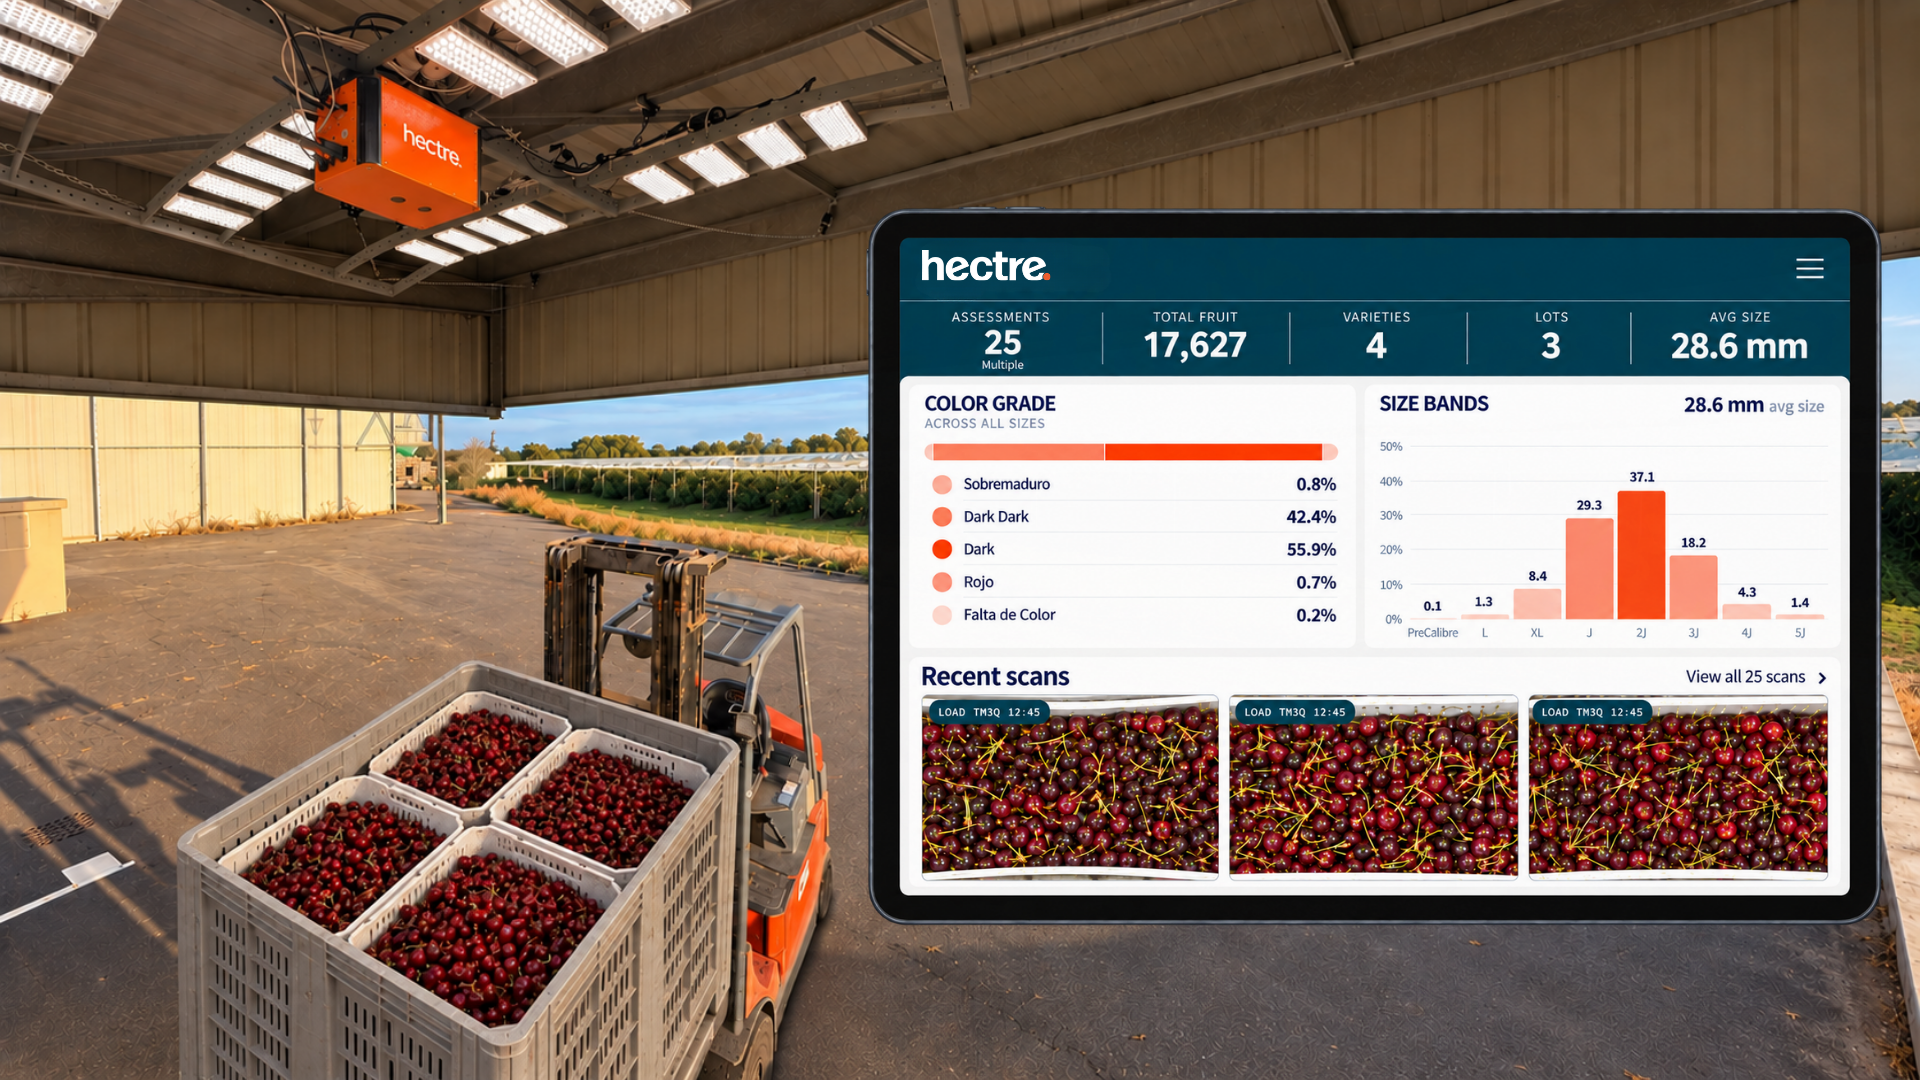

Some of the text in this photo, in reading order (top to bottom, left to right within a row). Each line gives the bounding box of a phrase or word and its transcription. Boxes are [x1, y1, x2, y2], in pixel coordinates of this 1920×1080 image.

[951, 312, 1050, 323] ASSESSMENTS
[1153, 312, 1238, 323] TOTAL FRUIT
[1342, 312, 1411, 323] VARIETIES
[1535, 312, 1569, 323] LOTS
[1709, 312, 1771, 323] AVG SIZE
[985, 330, 1021, 355] 25
[1145, 331, 1246, 363] 17,627
[1366, 332, 1387, 358] 4
[1542, 332, 1560, 359] 3
[1672, 333, 1807, 359] 28.6 mm
[982, 360, 1024, 371] Multiple
[925, 396, 1055, 411] COLOR GRADE
[1380, 396, 1489, 411] SIZE BANDS
[1685, 397, 1824, 415] 28.6 mm avg size
[924, 418, 1045, 429] ACROSS ALL SIZES
[1379, 442, 1404, 452] 50%
[1379, 477, 1404, 487] 40%
[1629, 472, 1655, 483] 37.1
[964, 477, 1050, 490] Sobremaduro
[1297, 477, 1336, 491] 0.8%
[1576, 500, 1603, 511] 29.3
[965, 510, 1029, 522] Dark Dark
[1287, 510, 1336, 523] 42.4%
[1379, 511, 1404, 521] 30%
[965, 542, 994, 555] Dark
[1681, 538, 1707, 548] 18.2
[1288, 543, 1336, 556] 55.9%
[1379, 545, 1404, 555] 20%
[1528, 571, 1548, 582] 8.4
[965, 576, 994, 591] Rojo
[1297, 576, 1336, 589] 0.7%
[1380, 580, 1404, 590] 10%
[1737, 587, 1757, 598] 4.3
[1423, 601, 1442, 612] 0.1
[1474, 597, 1493, 607] 1.3
[1791, 598, 1810, 608] 1.4
[965, 608, 1056, 620] Falta de Color
[1297, 609, 1336, 622] 0.2%
[1385, 615, 1403, 625] 0%
[1407, 628, 1459, 638] PreCalibre
[1482, 628, 1489, 638] L
[1530, 628, 1544, 638] XL
[1586, 628, 1593, 638] J
[1636, 628, 1647, 639] 2J
[1688, 628, 1699, 639] 3J
[1741, 628, 1752, 639] 4J
[1794, 628, 1806, 639] 5J
[922, 667, 1069, 686] Recent scans
[1686, 669, 1806, 684] View all 25 scans
[938, 707, 1041, 719] LOAD TM3Q 12:45
[1244, 707, 1346, 718] LOAD TM3Q 12:45
[1541, 707, 1643, 719] LOAD TM3Q 12:45
